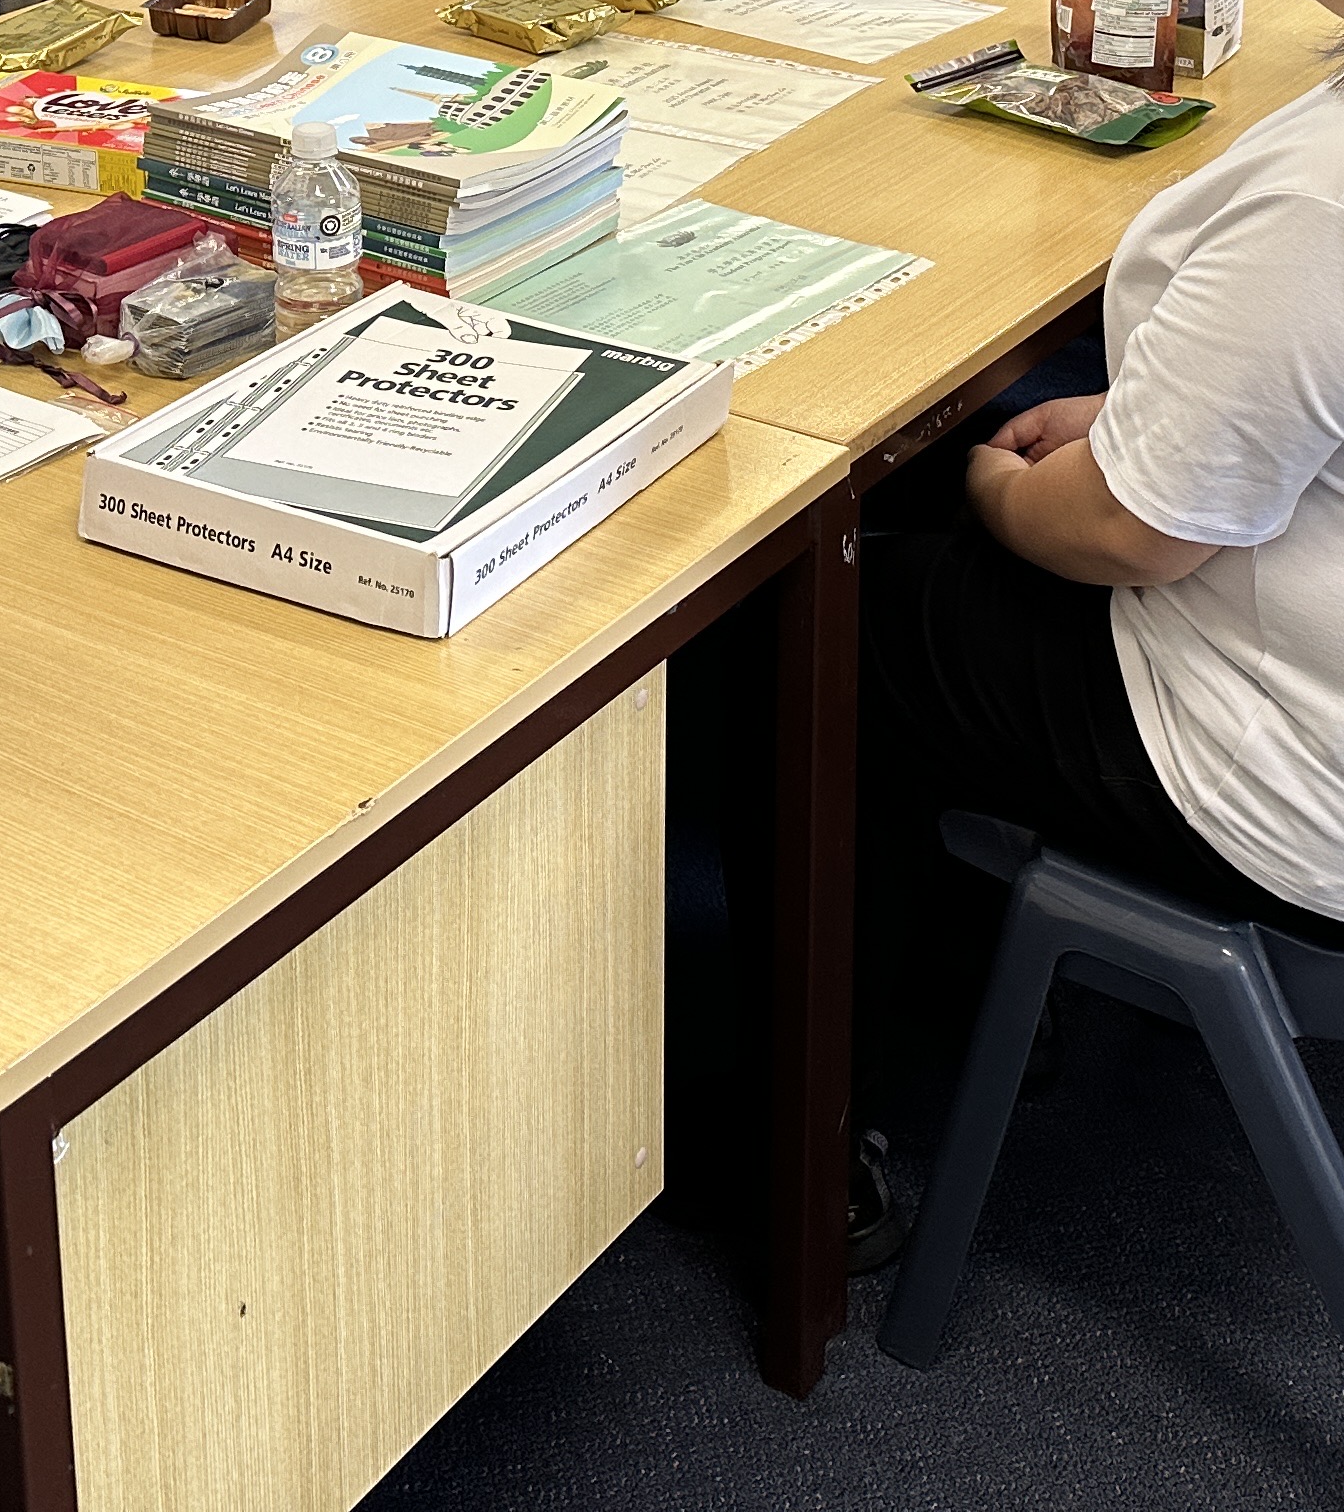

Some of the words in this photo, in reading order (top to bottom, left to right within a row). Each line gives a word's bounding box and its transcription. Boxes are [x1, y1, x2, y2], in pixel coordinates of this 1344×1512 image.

[307, 46, 333, 62] 8
[42, 105, 129, 121] Letters
[45, 93, 148, 115] Love
[426, 349, 494, 370] 300
[601, 350, 675, 372] marbig
[393, 362, 496, 389] Sheet
[336, 370, 519, 411] Protectors
[354, 410, 365, 418] for
[371, 399, 390, 408] duty
[433, 408, 463, 420] binding
[465, 415, 486, 424] edge
[387, 408, 409, 418] sheet
[409, 413, 449, 425] punching
[344, 427, 374, 438] tearing
[364, 424, 381, 432] and
[389, 428, 406, 437] ring
[407, 431, 438, 441] binders
[474, 557, 496, 586] 300
[498, 532, 529, 567] Sheet
[532, 492, 589, 541] Protectors
[598, 473, 613, 494] A4
[615, 457, 638, 481] Size
[98, 493, 126, 515] 300
[131, 502, 172, 530] Sheet
[177, 516, 256, 553] Protectors
[271, 543, 294, 564] A4
[299, 550, 333, 575] Size
[358, 575, 374, 589] Ref.
[375, 580, 389, 592] No.
[390, 584, 415, 598] 25170
